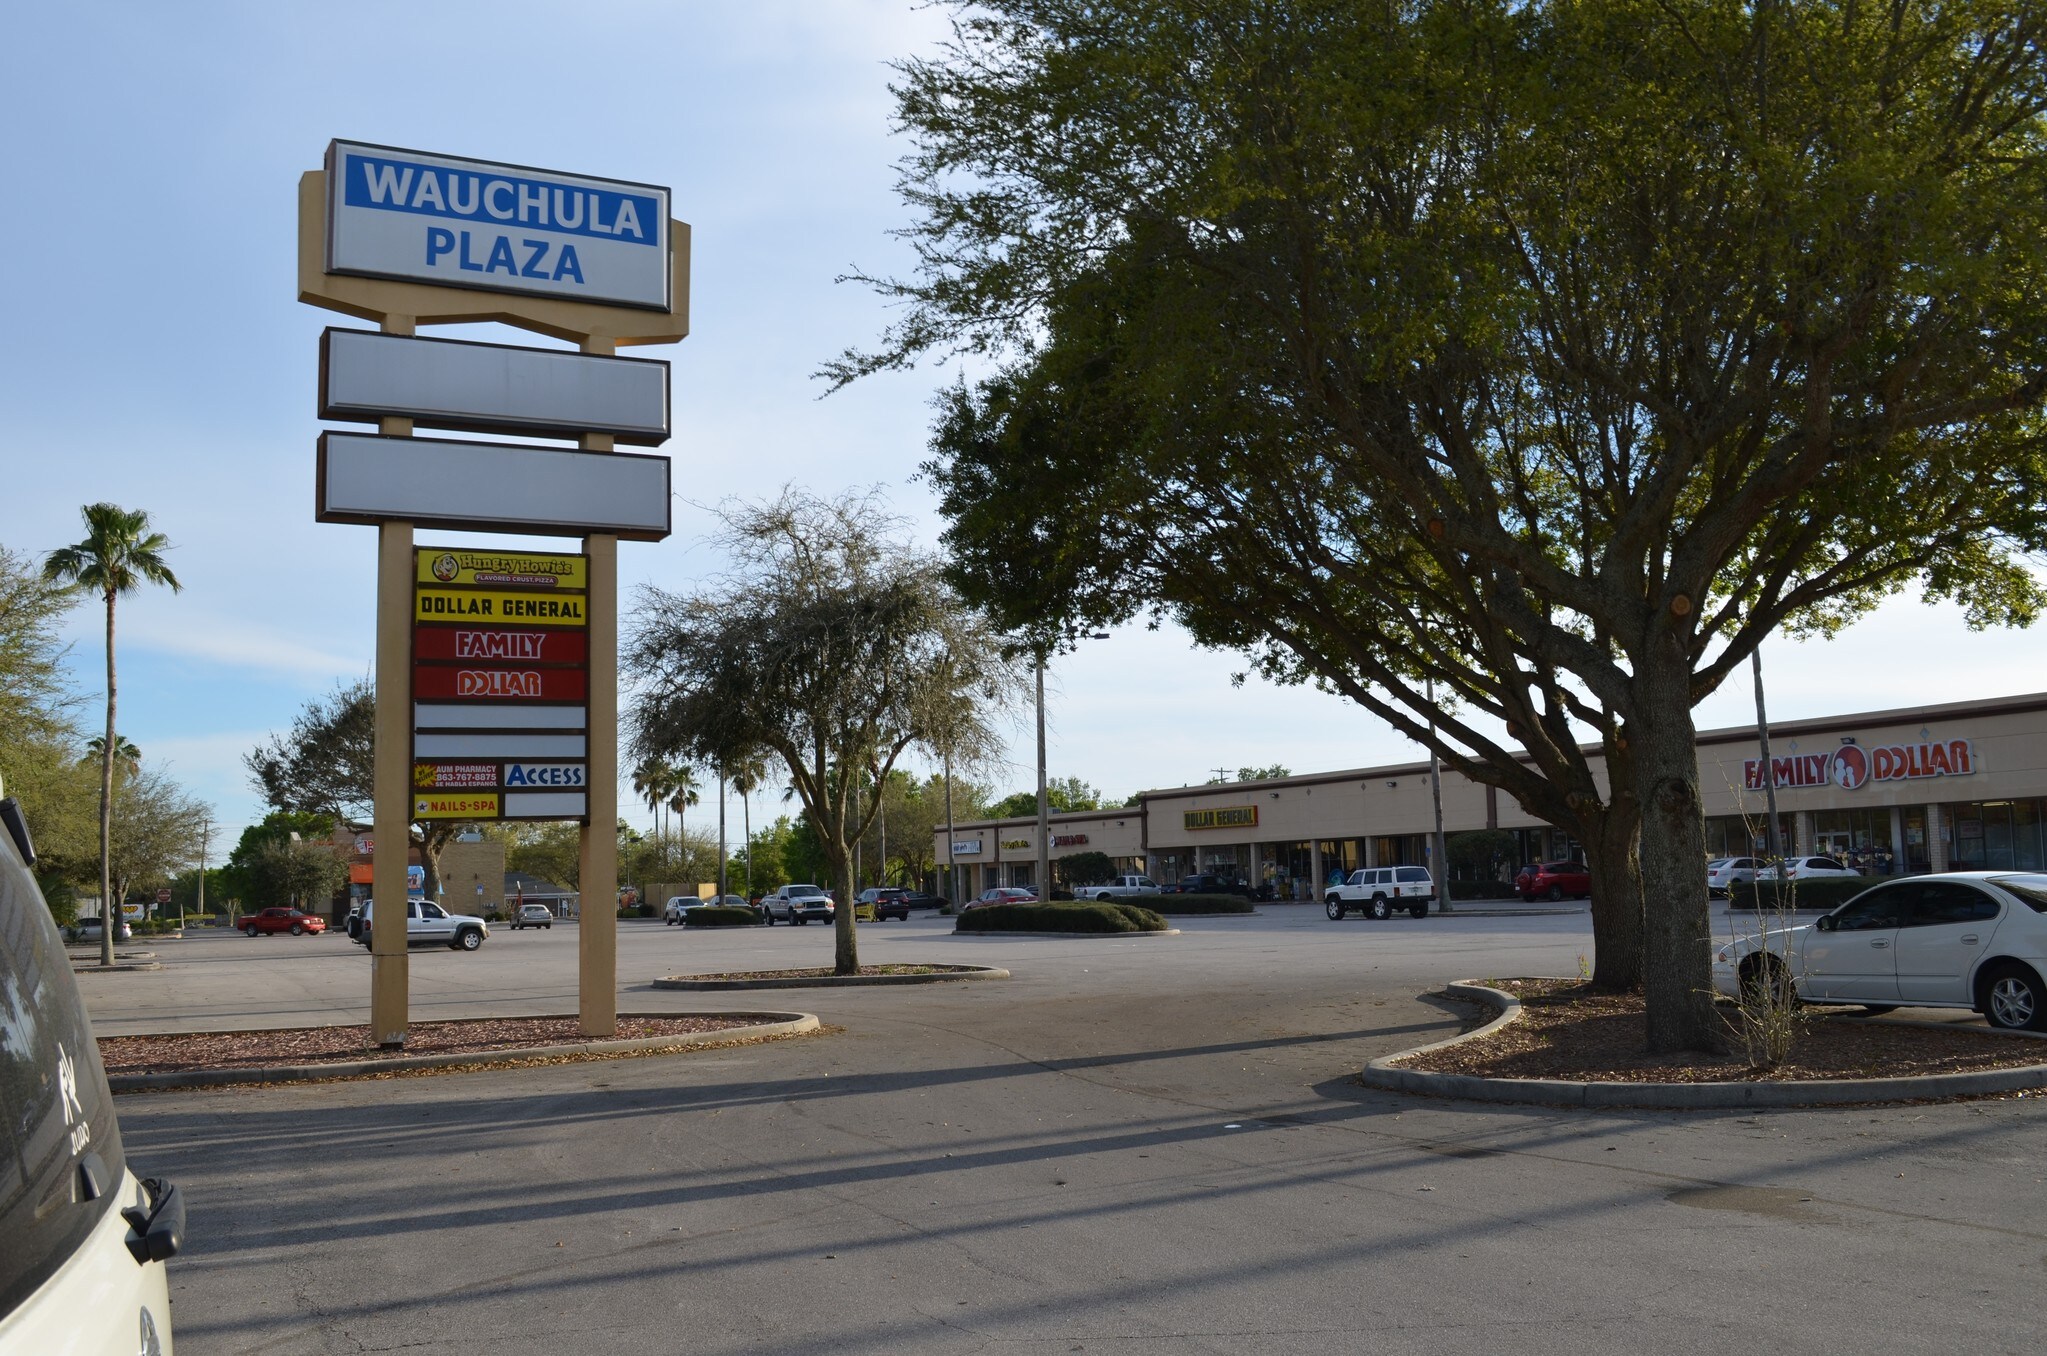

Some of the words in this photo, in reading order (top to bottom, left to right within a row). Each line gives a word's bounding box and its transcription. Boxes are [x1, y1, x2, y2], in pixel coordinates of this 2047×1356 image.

[363, 162, 644, 239] WAUCHULA
[426, 226, 585, 284] PLAZA
[460, 555, 518, 573] Hungry
[519, 560, 573, 575] Howie's
[421, 597, 493, 615] DOLLAR
[503, 600, 582, 618] GENERAL
[456, 632, 547, 659] FAMILY
[457, 670, 542, 697] DOLLAR
[436, 765, 454, 773] AUM
[455, 765, 497, 773] PHARMACY
[1871, 739, 1974, 782] DOLLAR
[1184, 812, 1214, 828] DOLLAR
[1216, 809, 1252, 826] GENERAL
